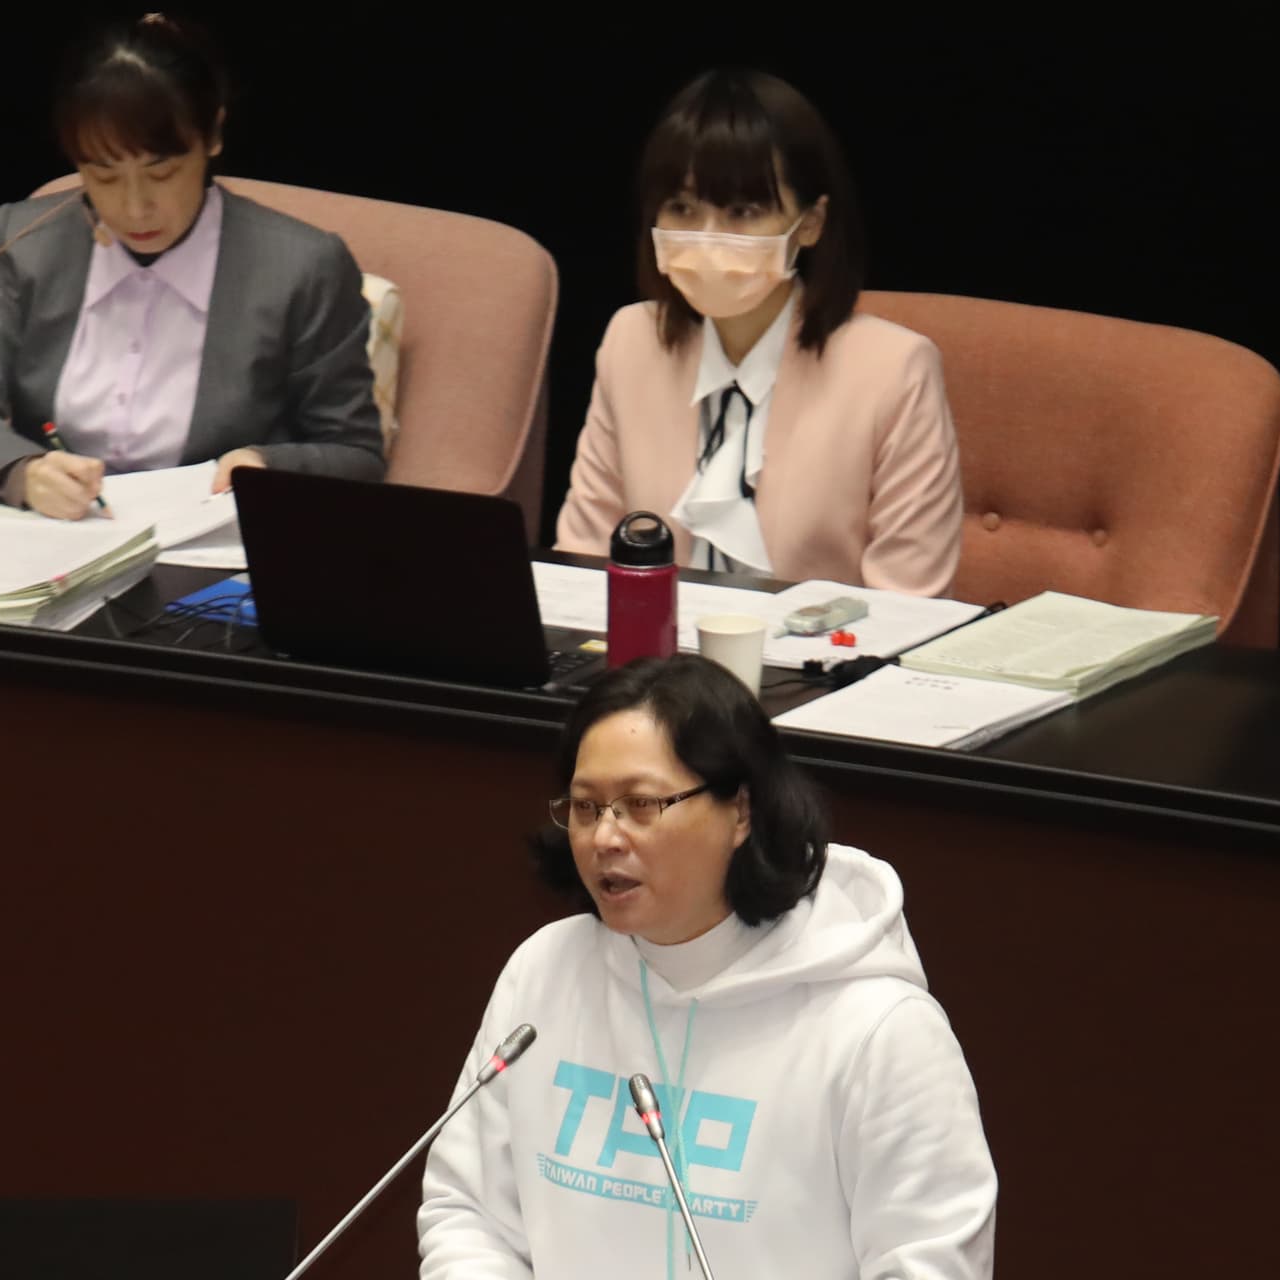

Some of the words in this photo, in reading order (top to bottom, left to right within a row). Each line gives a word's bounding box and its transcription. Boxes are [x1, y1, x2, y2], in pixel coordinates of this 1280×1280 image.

[553, 1059, 758, 1173] TPP
[545, 1161, 597, 1192] TAIWAN
[601, 1179, 673, 1204] PEOPLE'
[682, 1194, 741, 1217] ARTY
